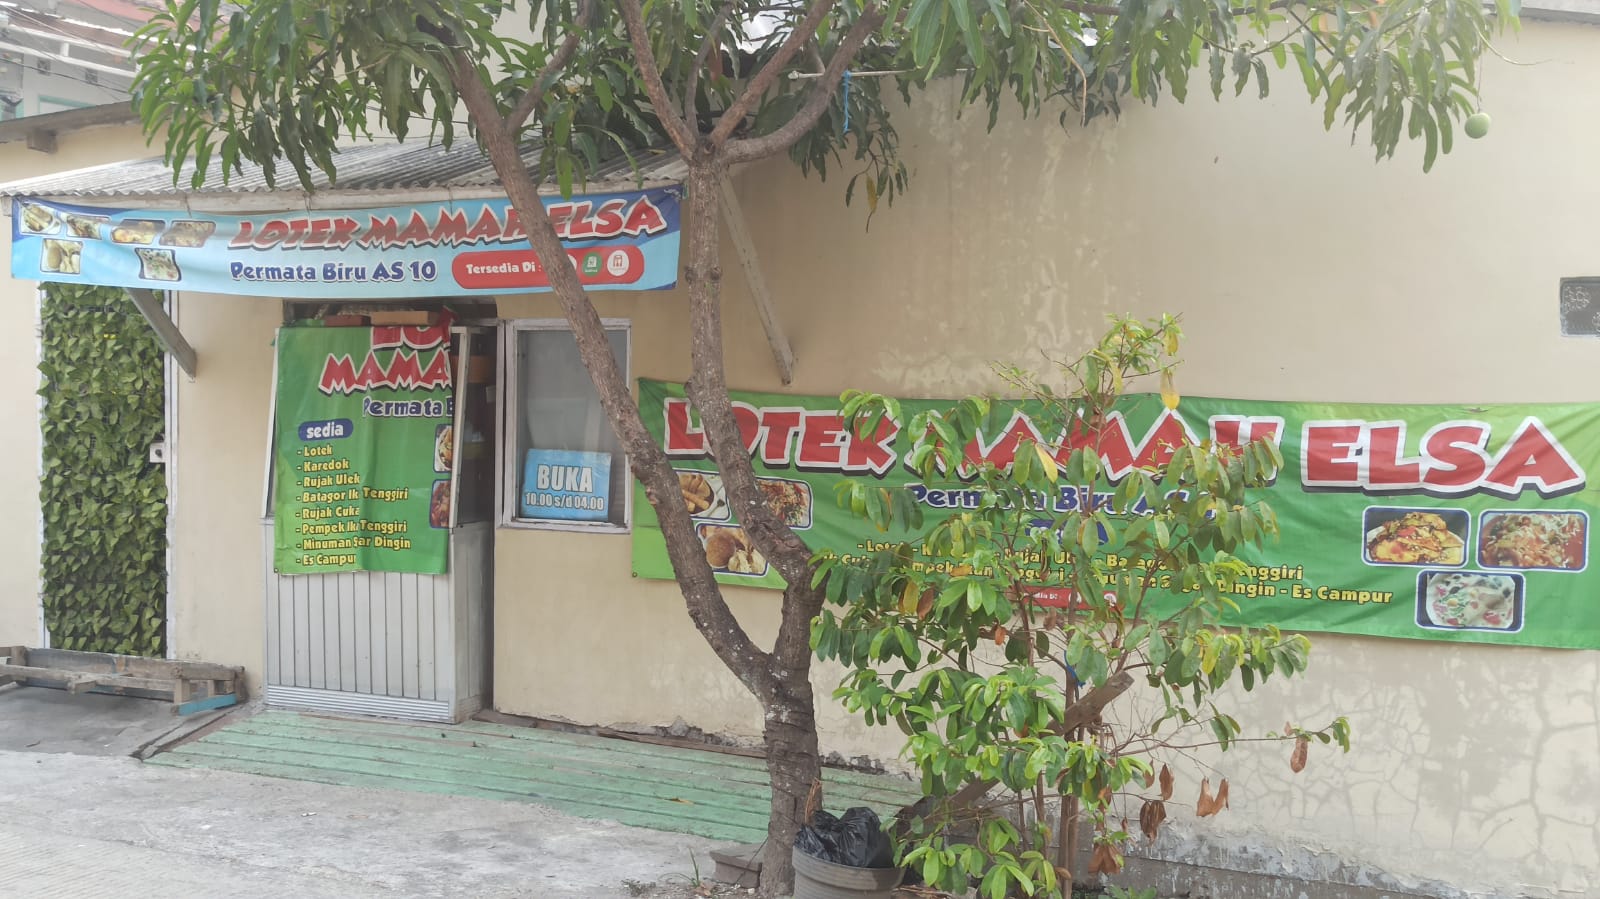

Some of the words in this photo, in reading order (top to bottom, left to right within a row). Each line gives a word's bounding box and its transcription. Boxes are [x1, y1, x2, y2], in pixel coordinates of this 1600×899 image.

[229, 217, 361, 250] LOTEK
[546, 196, 668, 240] ELSA
[229, 261, 317, 282] Permata
[322, 262, 367, 282] Biru
[371, 261, 405, 281] AS
[408, 259, 438, 281] 10
[466, 261, 520, 275] Tersedia
[522, 260, 536, 273] Di
[306, 423, 344, 439] sedia
[303, 445, 333, 457] Lotek
[1301, 416, 1586, 500] ELSA
[303, 459, 350, 472] Karedok
[303, 475, 333, 488] Rujak
[335, 473, 361, 485] Ulek
[536, 464, 593, 493] BUKA
[302, 492, 346, 504] Batagor
[362, 486, 409, 502] Tenggiri
[525, 492, 553, 507] 10.00
[554, 494, 573, 509] s/d
[574, 495, 605, 512] 04.00
[302, 508, 333, 520] Rujak
[302, 521, 345, 536] Pempek
[359, 519, 407, 535] Tenggiri
[303, 537, 352, 551] Minuman
[374, 535, 412, 551] Dingin
[302, 553, 315, 566] Es
[1291, 584, 1313, 599] Es
[1316, 585, 1394, 604] Campur
